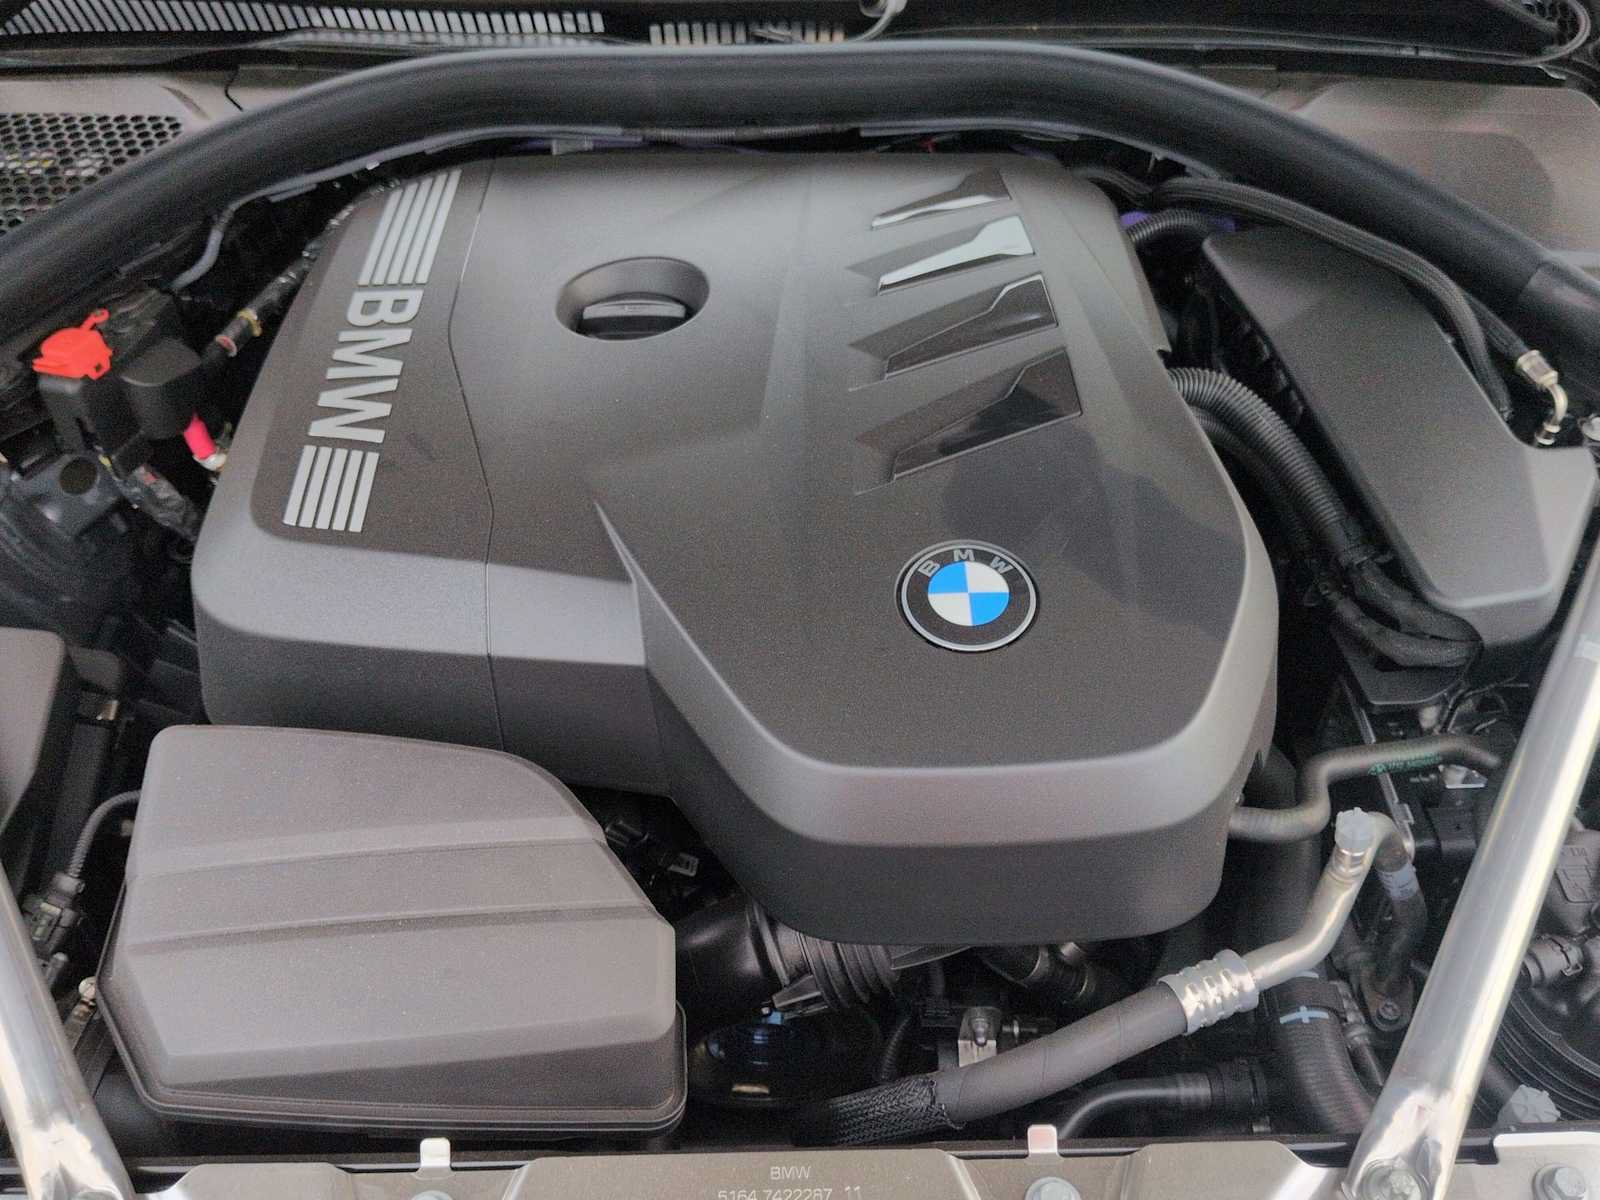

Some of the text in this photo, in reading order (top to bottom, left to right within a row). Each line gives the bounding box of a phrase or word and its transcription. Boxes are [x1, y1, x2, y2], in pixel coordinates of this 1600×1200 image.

[308, 289, 424, 444] BMW
[917, 549, 1014, 578] BMW
[770, 1166, 812, 1180] BMW
[718, 1189, 757, 1200] 5164
